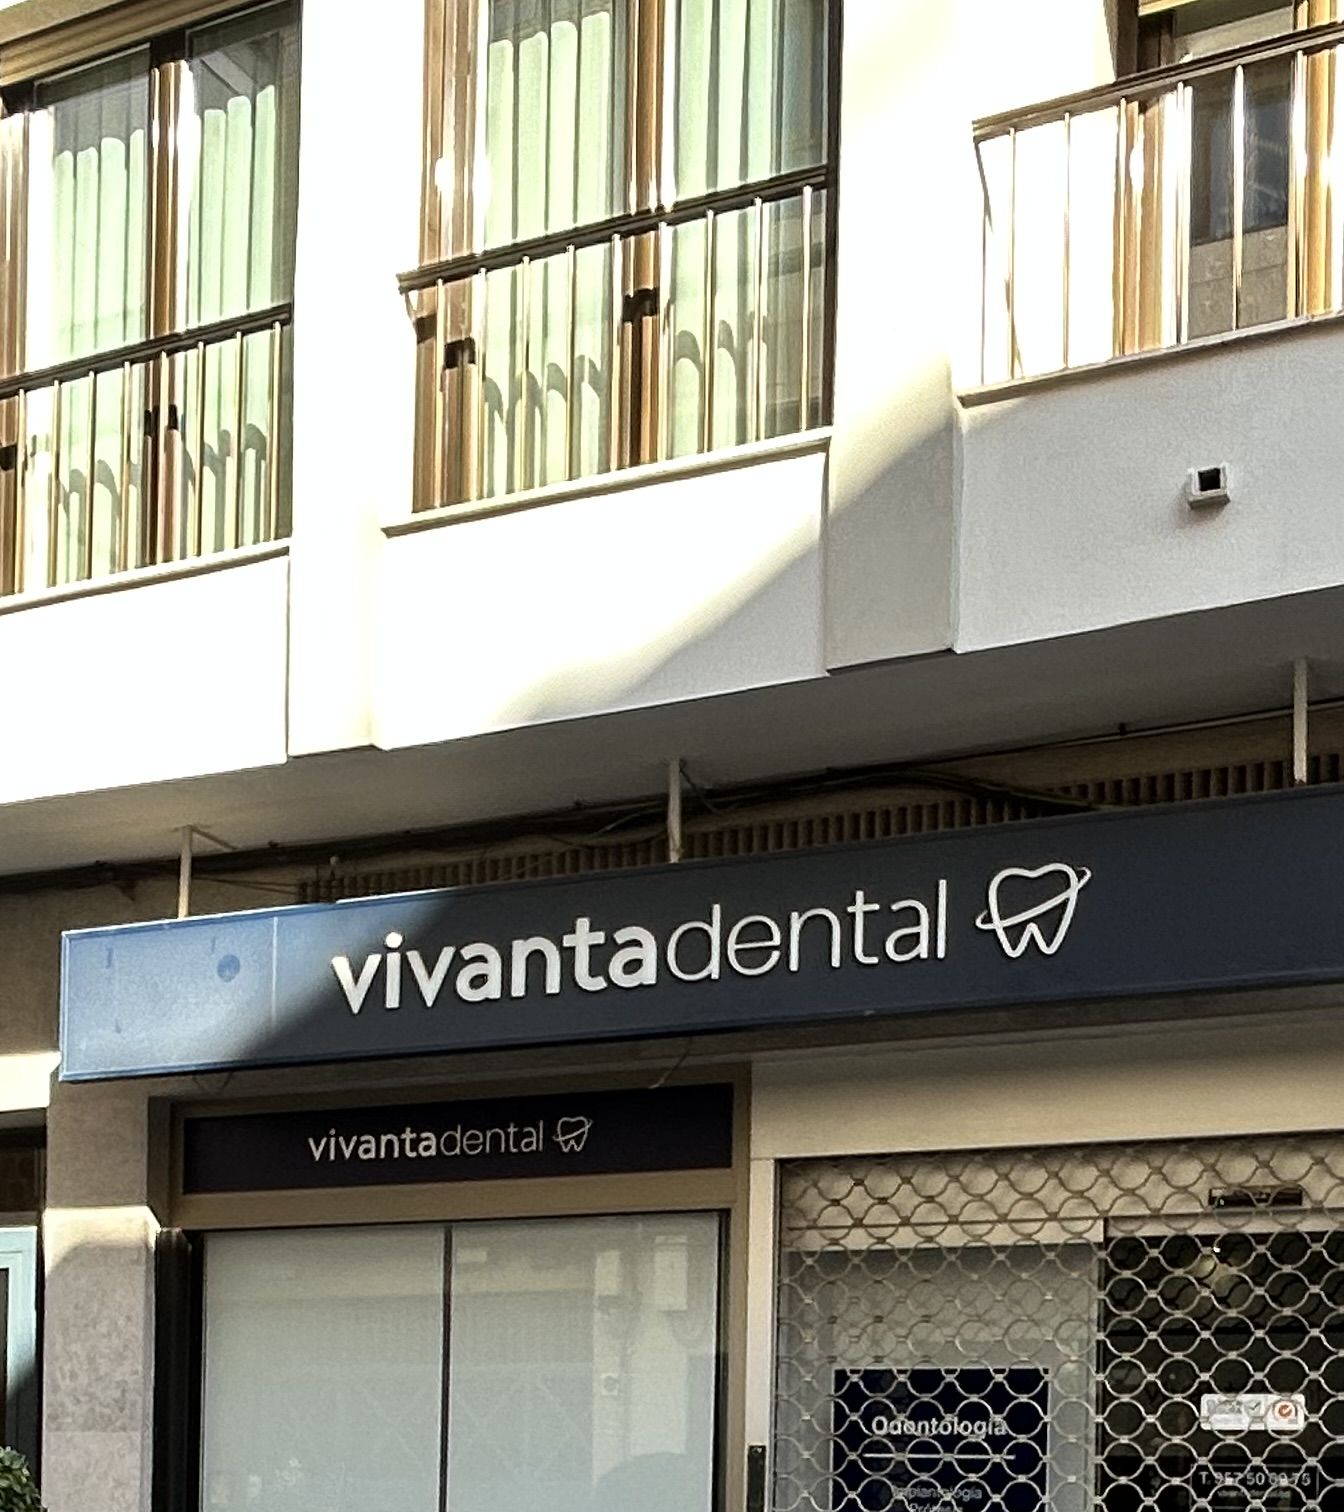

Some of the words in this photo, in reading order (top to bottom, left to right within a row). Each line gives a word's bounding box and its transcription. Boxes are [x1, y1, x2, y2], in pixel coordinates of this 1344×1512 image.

[330, 878, 949, 1015] vivantadental
[308, 1119, 544, 1162] vivantadental
[1246, 1472, 1265, 1486] 50
